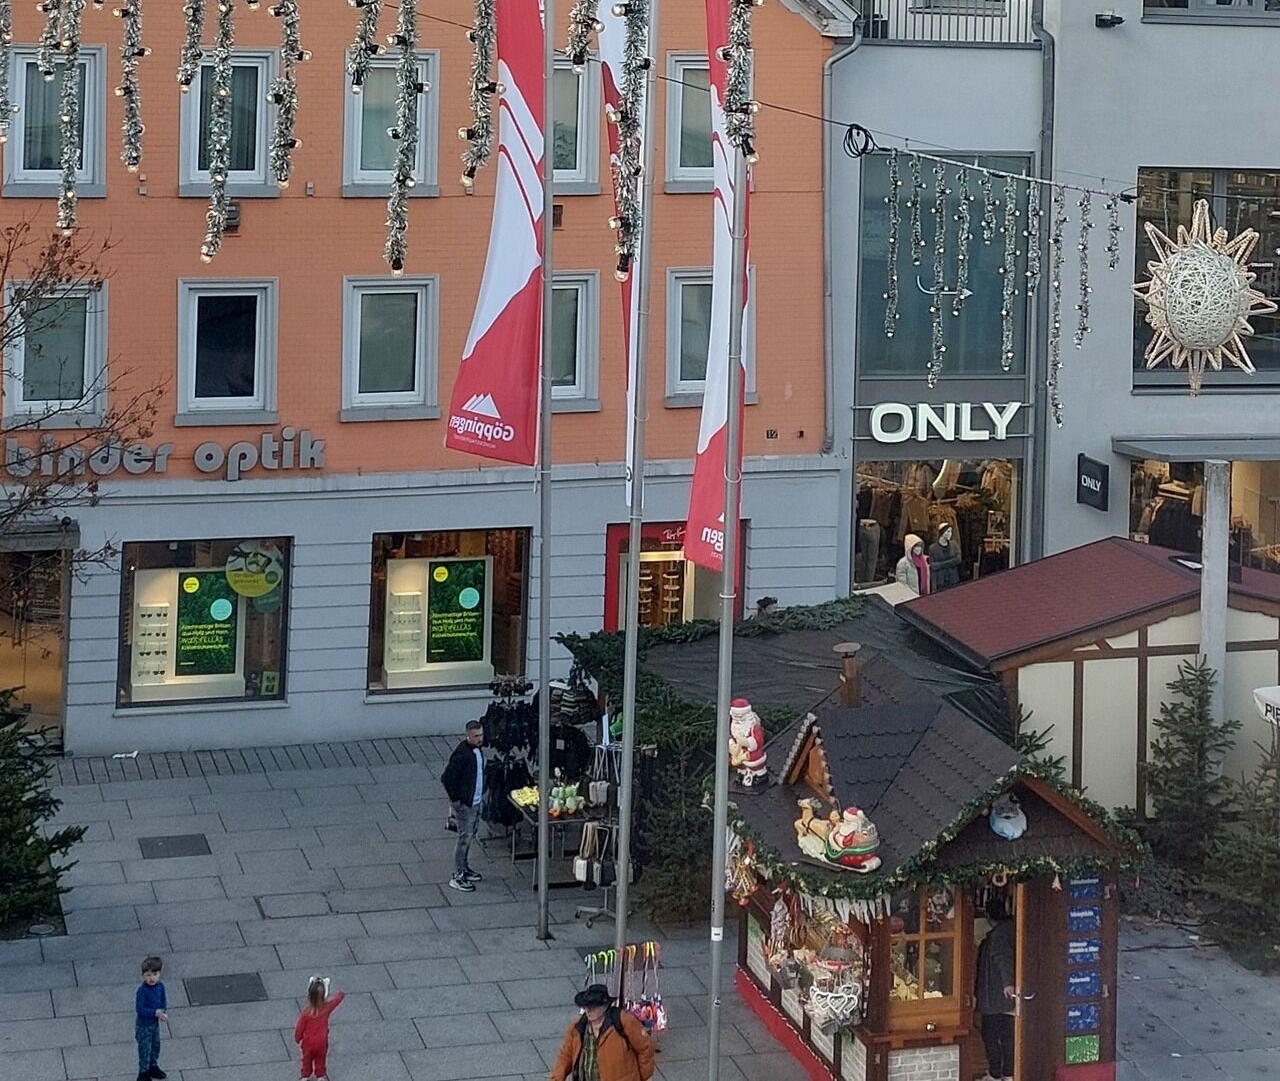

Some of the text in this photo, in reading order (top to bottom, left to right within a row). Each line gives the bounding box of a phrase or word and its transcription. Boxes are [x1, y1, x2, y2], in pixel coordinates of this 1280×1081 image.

[870, 401, 1022, 443] ONLY
[4, 426, 327, 482] binder optik
[1080, 474, 1103, 493] ONLY
